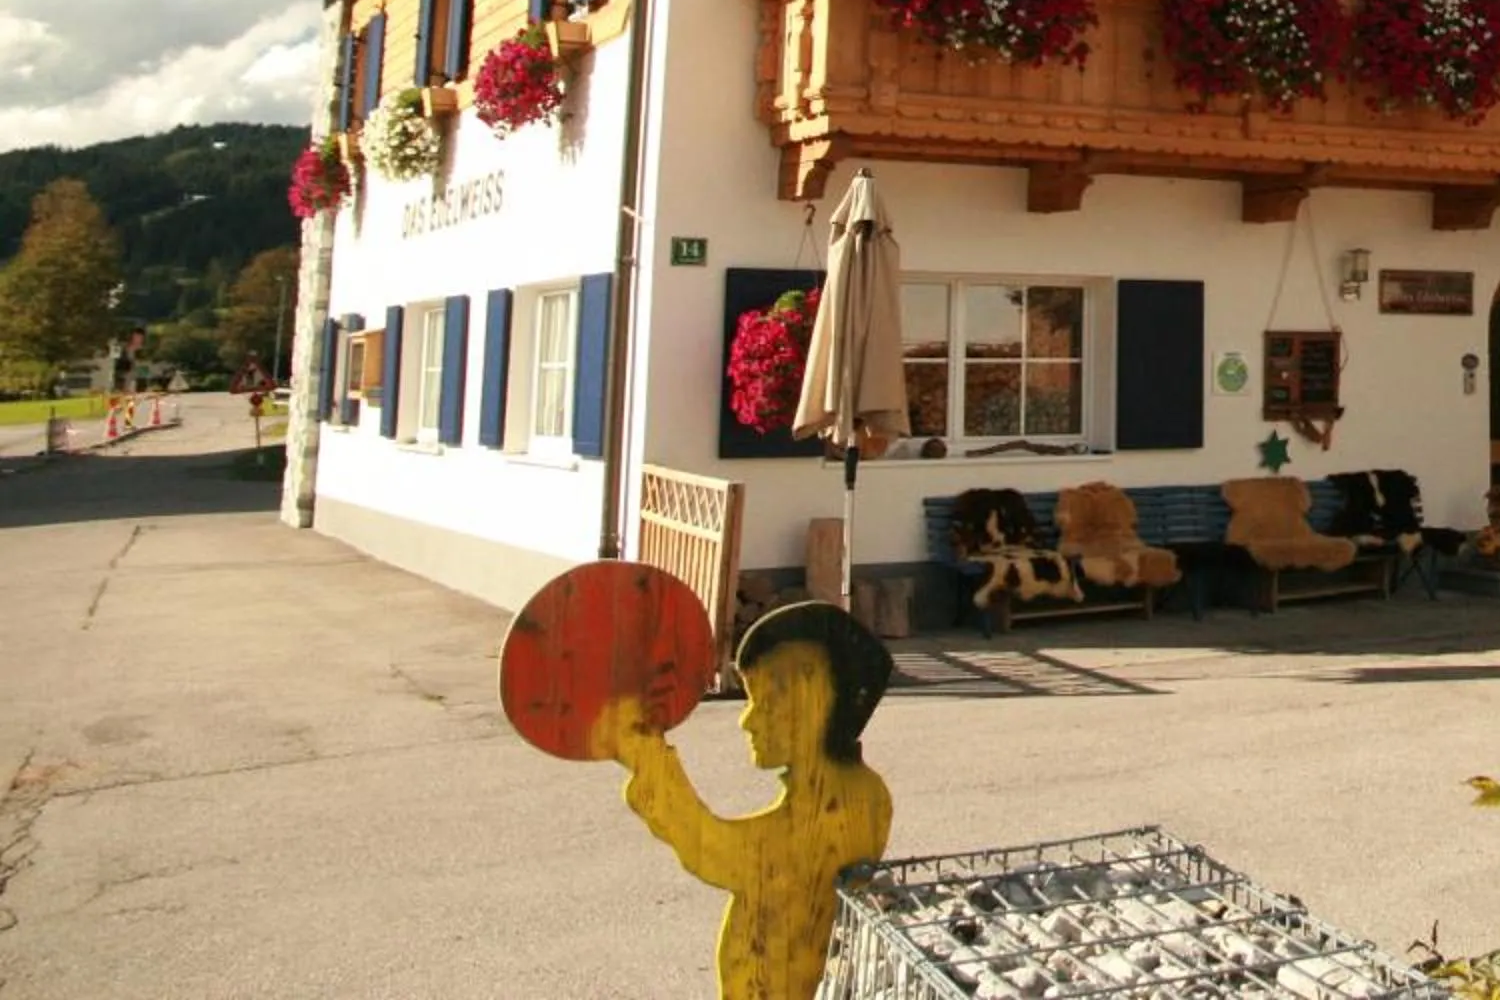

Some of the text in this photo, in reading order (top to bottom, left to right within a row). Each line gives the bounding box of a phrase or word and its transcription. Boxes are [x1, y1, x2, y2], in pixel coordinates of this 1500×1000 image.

[402, 169, 505, 240] DAS EDELWEISS
[681, 241, 700, 257] 14
